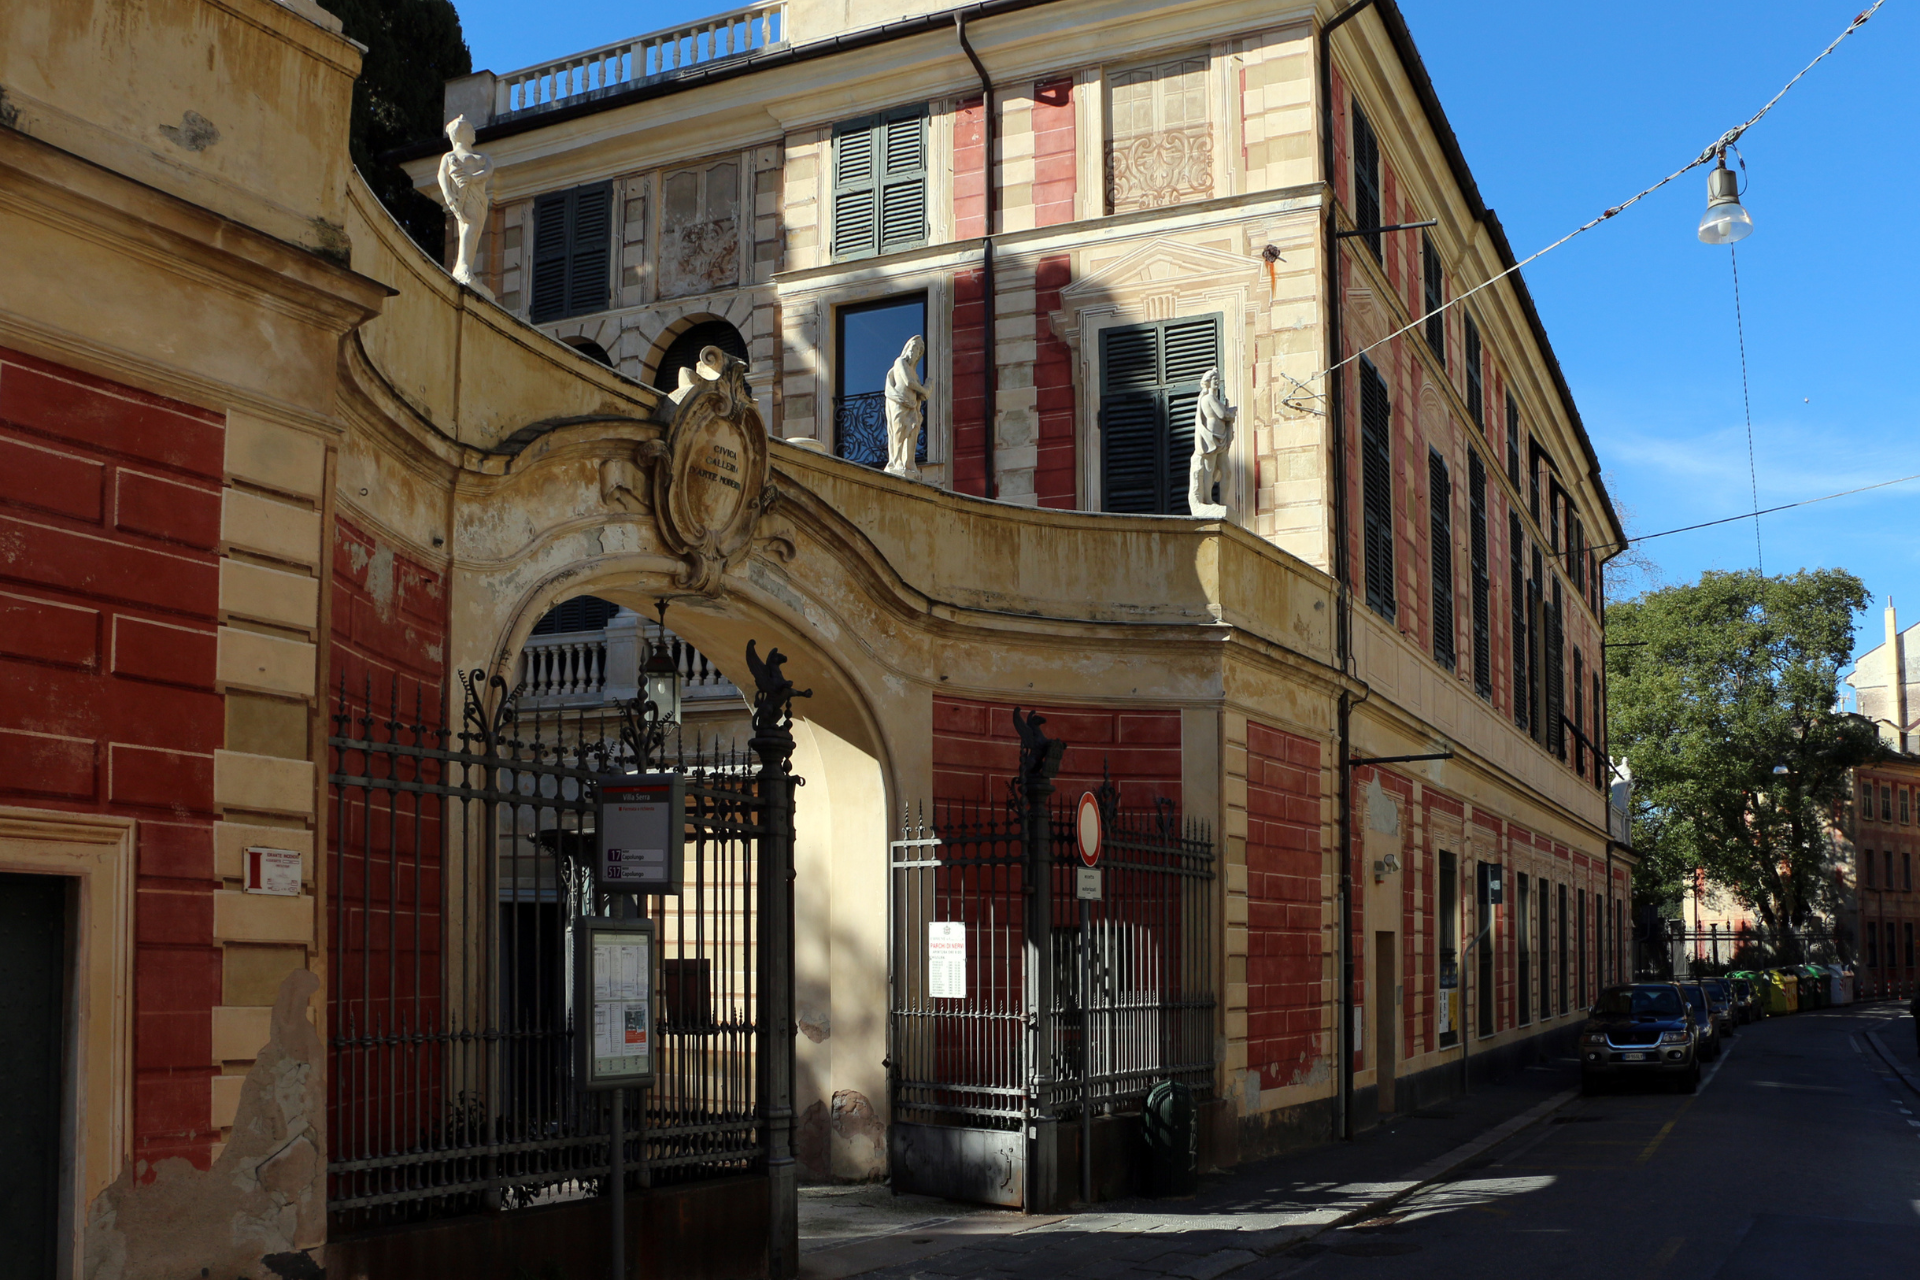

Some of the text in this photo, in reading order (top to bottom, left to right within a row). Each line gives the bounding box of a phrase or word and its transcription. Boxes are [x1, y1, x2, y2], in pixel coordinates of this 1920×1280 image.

[714, 445, 737, 460] CIVICA
[689, 466, 718, 481] D'ARTE
[622, 793, 651, 801] Villa Serra
[611, 850, 621, 861] 17
